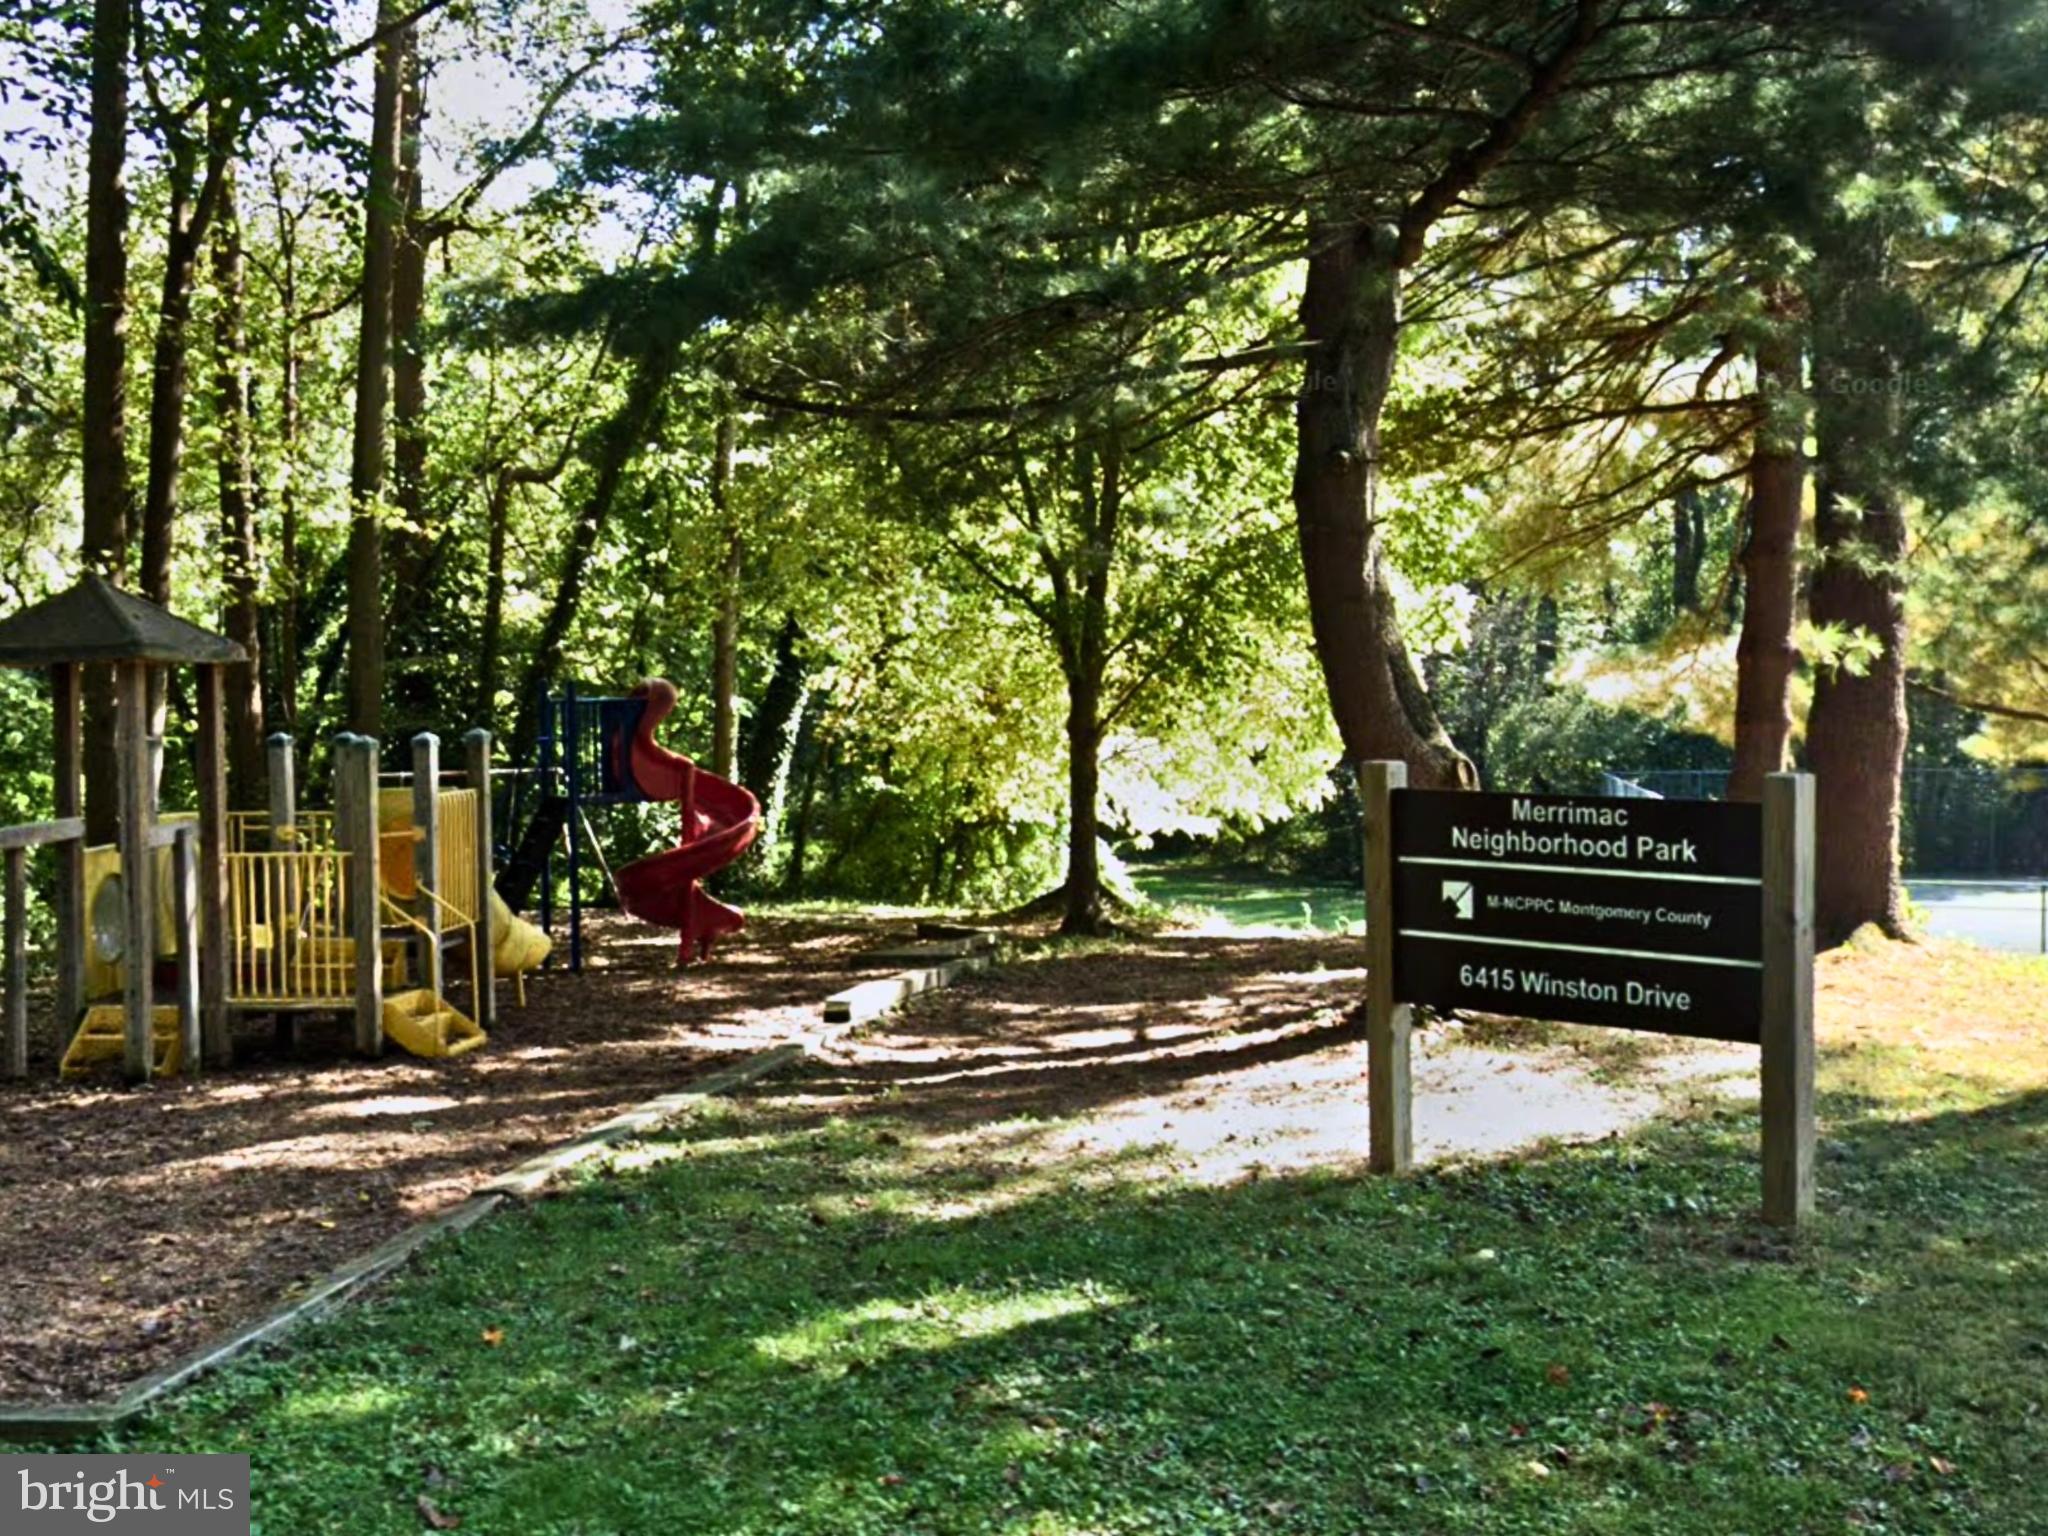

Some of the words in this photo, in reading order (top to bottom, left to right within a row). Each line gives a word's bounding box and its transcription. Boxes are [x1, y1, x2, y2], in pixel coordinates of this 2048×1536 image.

[1512, 797, 1629, 826] Merrimac
[1452, 825, 1627, 858] Neighborhood
[1637, 836, 1697, 863] Park
[1486, 894, 1555, 913] M-NCPPC
[1558, 900, 1651, 924] Montgomery
[1655, 907, 1712, 929] County
[1459, 964, 1515, 991] 6415
[1520, 970, 1618, 1002] Winston
[1625, 980, 1691, 1010] Drive
